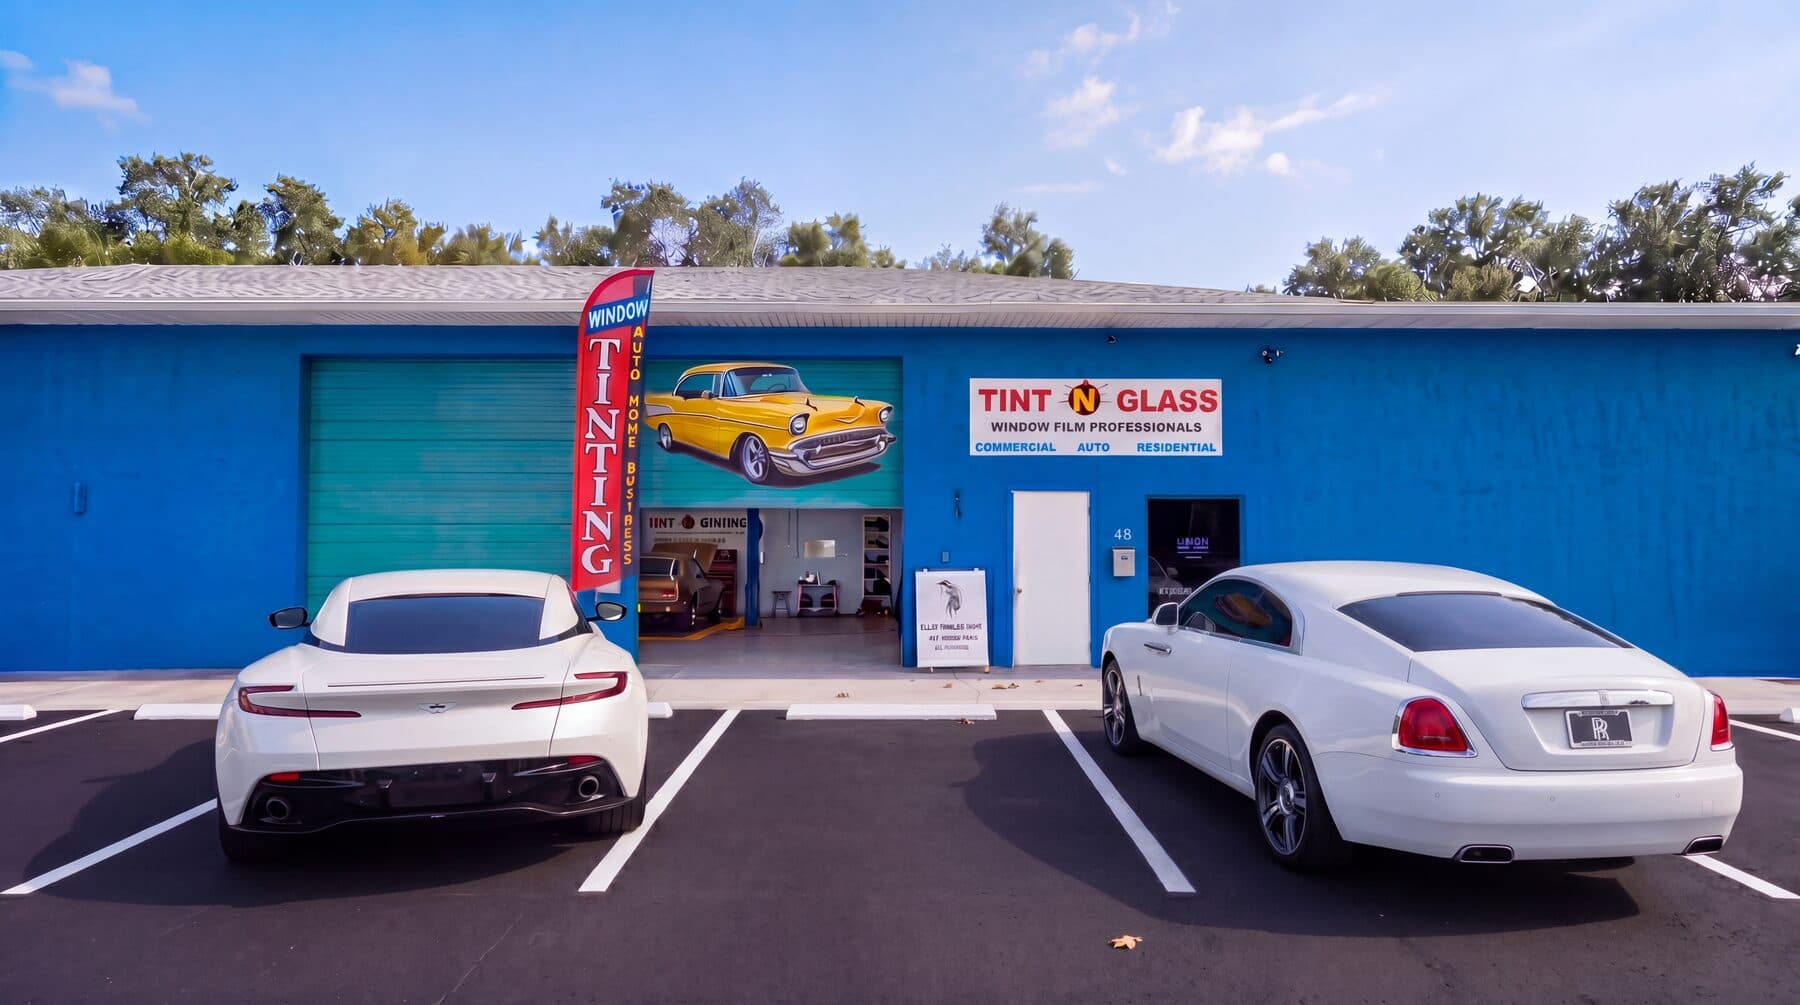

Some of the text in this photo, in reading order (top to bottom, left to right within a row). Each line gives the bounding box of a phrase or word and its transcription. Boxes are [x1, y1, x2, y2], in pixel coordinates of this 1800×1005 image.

[588, 299, 648, 329] WINDOW
[630, 326, 644, 380] AUTO
[978, 388, 1218, 413] TINT N GLASS
[627, 395, 640, 448] MOME
[991, 422, 1202, 433] WINDOW FILM PROFESSIONALS
[581, 338, 621, 575] TINTING
[975, 442, 1216, 453] COMMERCIAL AUTO RESIDENTIAL
[1113, 528, 1132, 541] 48
